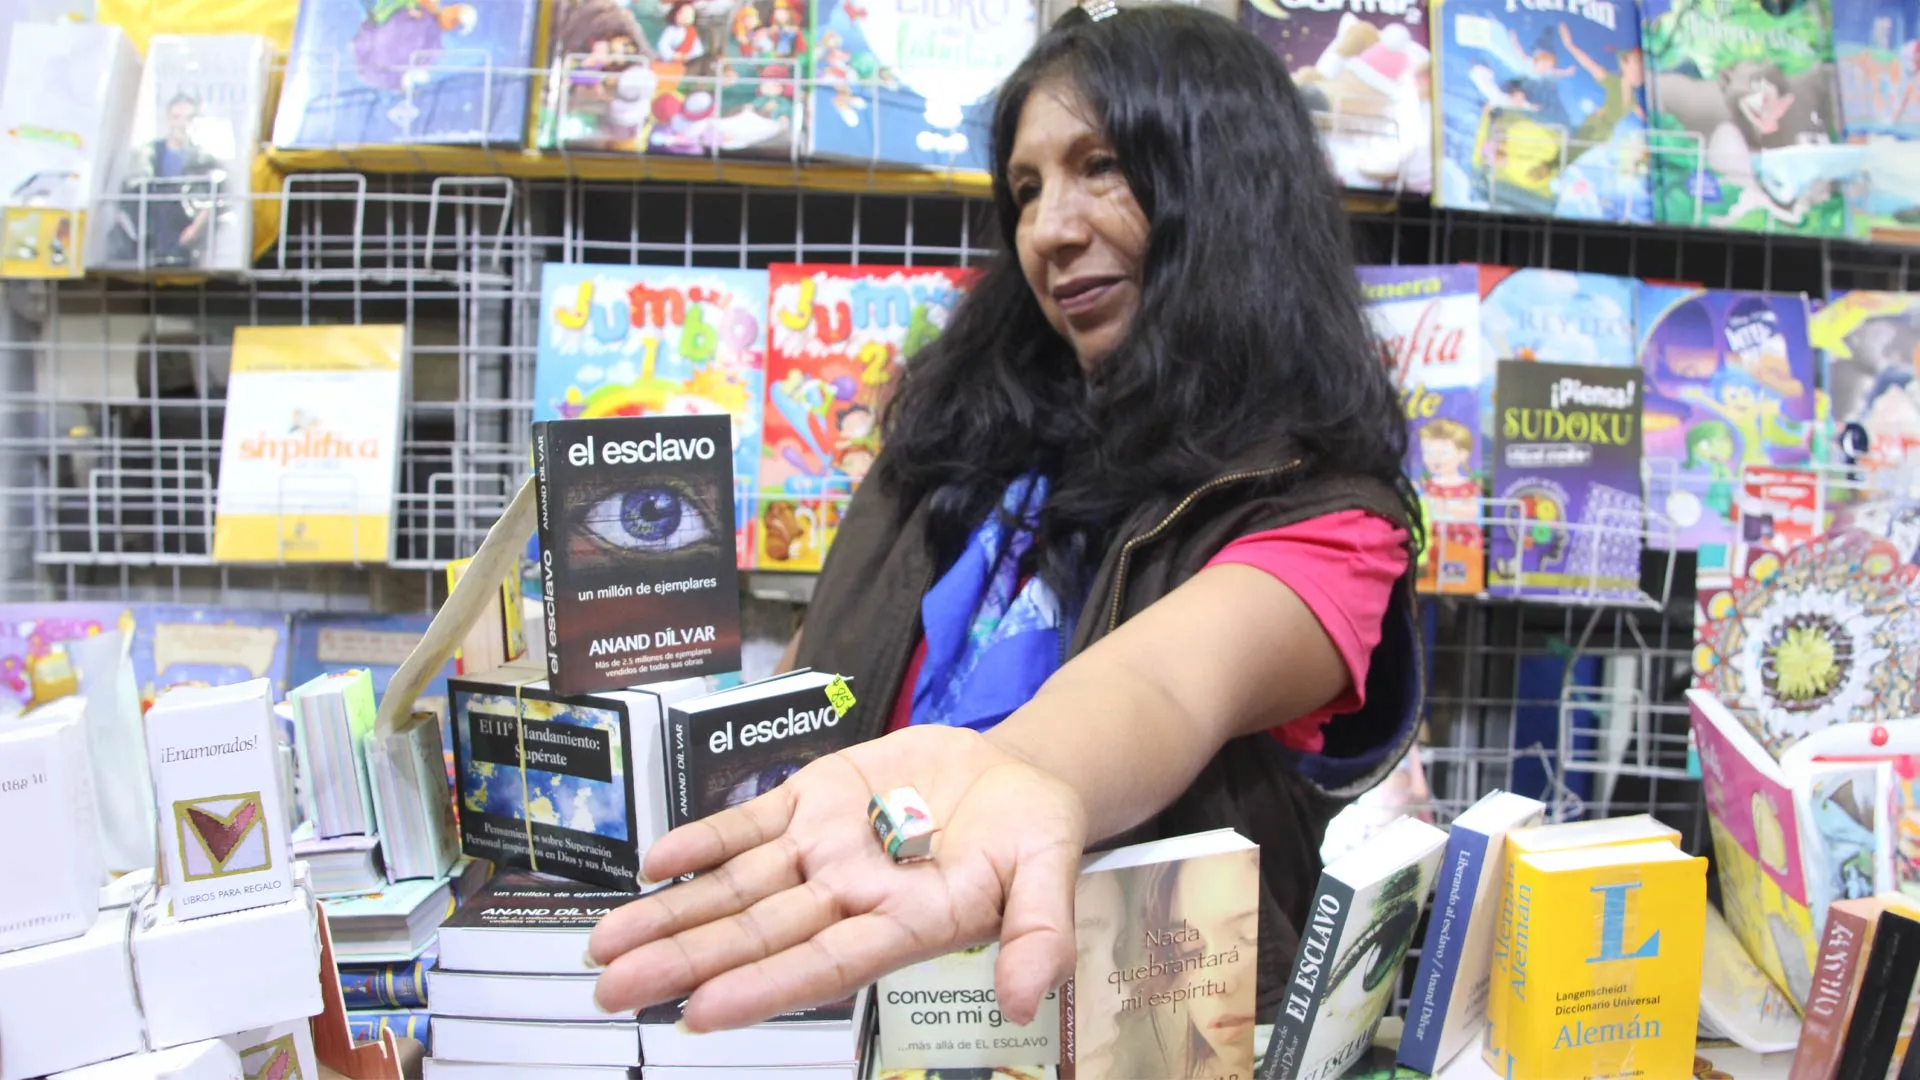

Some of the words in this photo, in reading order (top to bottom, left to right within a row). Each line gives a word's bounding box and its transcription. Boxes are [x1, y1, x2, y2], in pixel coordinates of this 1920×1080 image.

[554, 281, 759, 362] Jumbo
[778, 278, 943, 359] Jumb
[860, 342, 891, 386] 2
[1551, 378, 1635, 409] ¡Piensa!
[1503, 407, 1634, 445] SUDOKU
[239, 430, 379, 467] simplifica
[568, 434, 594, 466] el
[602, 432, 715, 465] esclavo
[540, 485, 549, 530] ANAND
[544, 549, 558, 646] esclavo
[578, 590, 594, 601] un
[597, 584, 632, 599] millón
[636, 582, 651, 596] de
[654, 577, 717, 595] ejemplares
[589, 633, 650, 657] ANAND
[655, 625, 716, 648] DÍLVAR
[595, 660, 610, 669] Más
[611, 658, 621, 667] de
[622, 656, 633, 666] 2.5
[634, 654, 664, 664] millones
[665, 651, 674, 660] de
[675, 647, 712, 660] ejemplares
[548, 652, 559, 674] el
[605, 665, 638, 678] vendidos
[638, 663, 648, 673] de
[649, 660, 670, 671] todas
[671, 659, 684, 668] sus
[684, 656, 704, 667] obras
[479, 718, 493, 733] El
[709, 721, 733, 754] el
[740, 704, 840, 747] esclavo
[161, 735, 259, 765] ¡Enamorados!
[676, 724, 685, 770] DÍLVAR
[677, 772, 689, 816] ANAND
[466, 833, 502, 850] Personal
[545, 848, 556, 860] en
[557, 848, 577, 865] Dios
[578, 857, 584, 869] y
[585, 858, 600, 870] sus
[600, 857, 634, 880] Ángeles
[541, 832, 564, 848] sobre
[565, 838, 612, 859] Superación
[182, 893, 216, 906] LIBROS
[218, 887, 242, 899] PARA
[244, 880, 282, 894] REGALO
[513, 889, 550, 898] millón
[554, 890, 570, 898] de
[1451, 850, 1471, 906] Liberando
[480, 907, 550, 916] ANAND
[554, 906, 612, 916] DÍLVA
[1448, 904, 1456, 919] al
[1585, 881, 1661, 964] L
[1145, 919, 1200, 948] Nada
[1295, 894, 1340, 993] ESCLAVO
[1437, 918, 1452, 959] esclavo
[1511, 884, 1531, 1004] Alemán
[1108, 945, 1240, 994] quebrantará
[1121, 989, 1143, 1012] mi
[1148, 978, 1227, 1014] espíritu
[1286, 991, 1311, 1023] EL
[1426, 970, 1441, 1008] Anand
[1555, 984, 1627, 1002] Langenscheidt
[1555, 1000, 1610, 1016] Diccionario
[1613, 994, 1661, 1008] Universal
[911, 1009, 951, 1025] con
[957, 1006, 982, 1024] mi
[1552, 1014, 1661, 1050] Alemán
[936, 1037, 954, 1049] allá
[957, 1038, 972, 1049] de
[975, 1038, 990, 1049] EL
[993, 1036, 1048, 1049] ESCLAVO
[1066, 1009, 1075, 1063] ANAND
